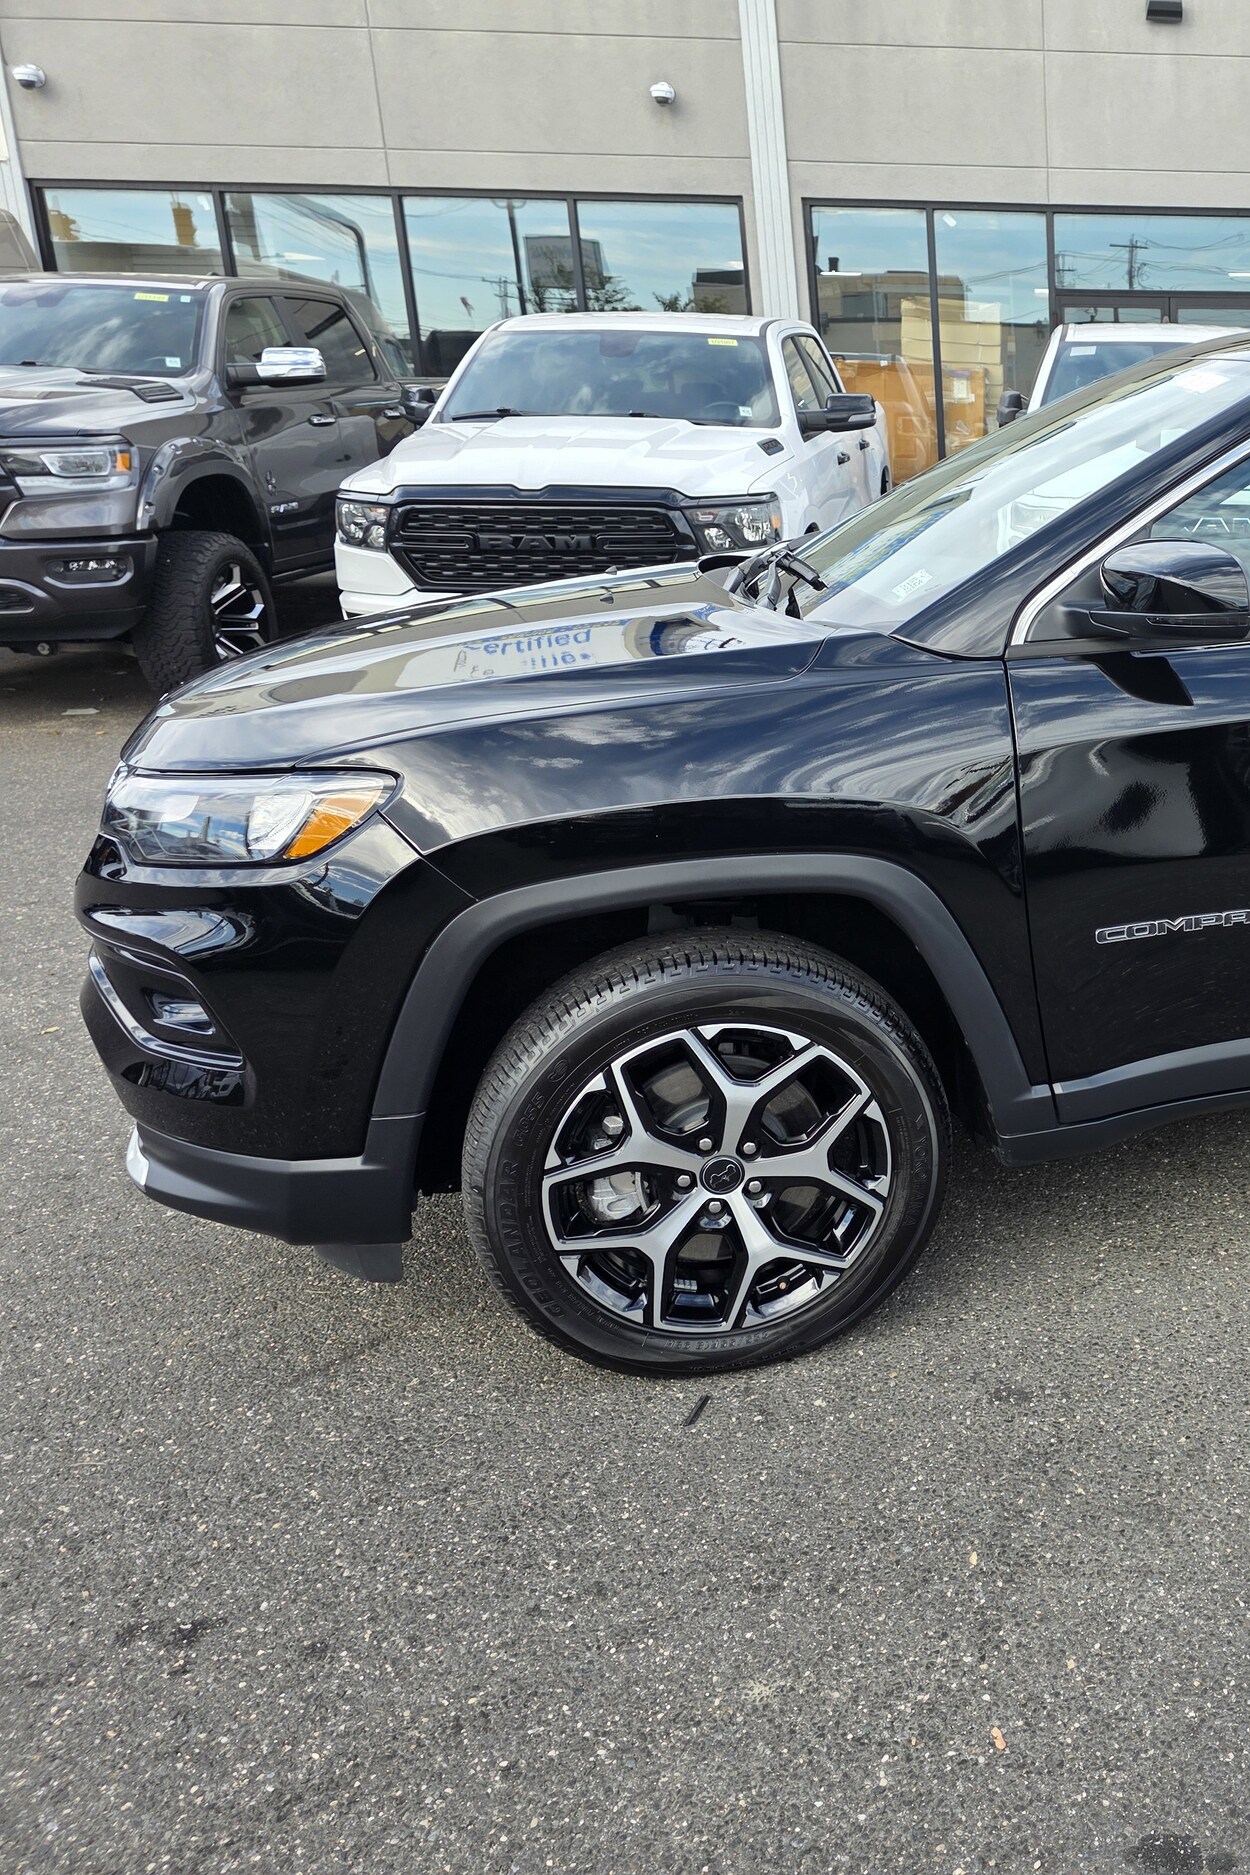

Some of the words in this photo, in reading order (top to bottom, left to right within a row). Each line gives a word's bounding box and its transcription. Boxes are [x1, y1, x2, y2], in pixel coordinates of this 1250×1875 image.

[478, 533, 592, 550] RAM
[464, 629, 592, 655] ertified
[902, 1135, 929, 1228] YOKOHAMA
[496, 1159, 568, 1320] GEOLANDAR
